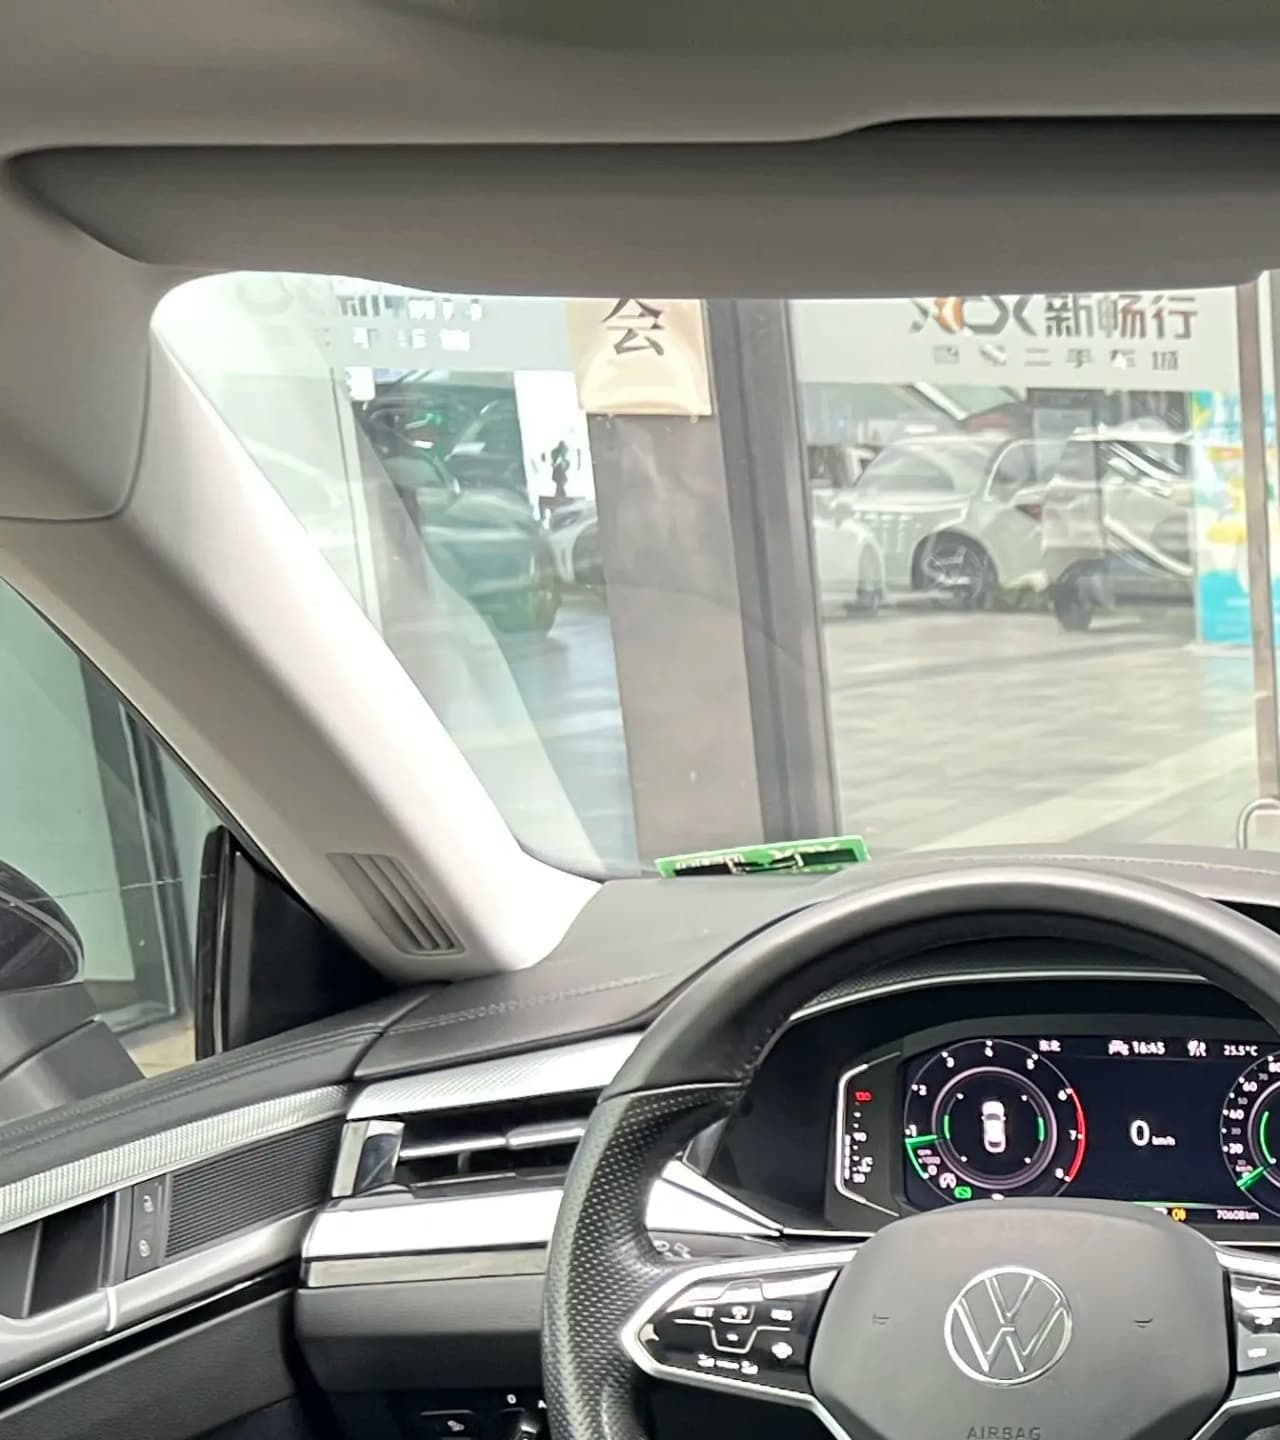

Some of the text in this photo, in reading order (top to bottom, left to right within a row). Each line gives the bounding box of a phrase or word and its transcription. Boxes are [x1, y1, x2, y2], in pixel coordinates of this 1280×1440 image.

[602, 298, 665, 357] 会
[1132, 1041, 1166, 1055] 16:45
[1242, 1081, 1258, 1092] 60
[1131, 1120, 1176, 1147] 0 km/h
[1228, 1143, 1244, 1154] 20
[966, 1426, 1042, 1440] AIRBAG
